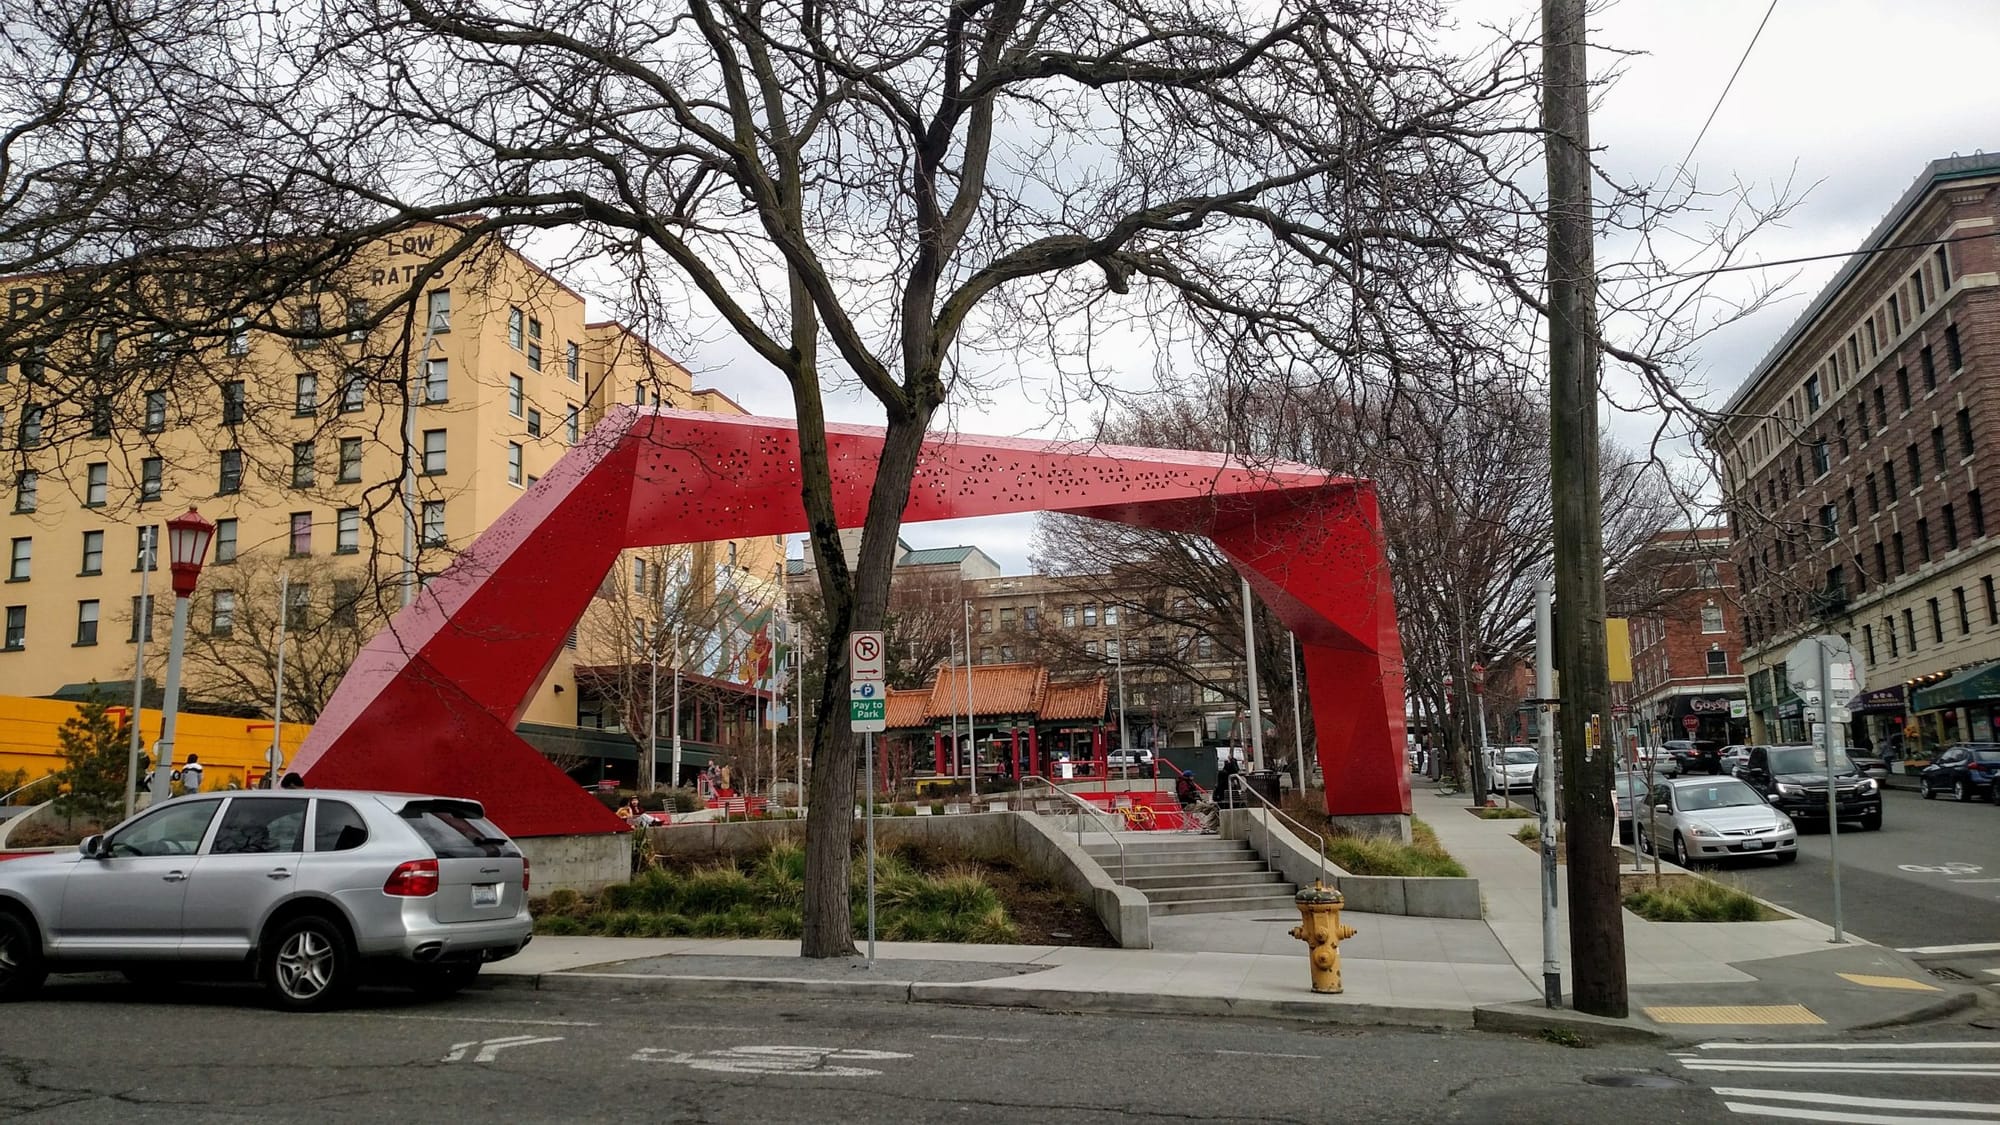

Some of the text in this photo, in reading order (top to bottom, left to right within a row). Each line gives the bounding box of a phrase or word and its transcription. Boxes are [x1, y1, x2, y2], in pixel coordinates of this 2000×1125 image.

[388, 234, 434, 256] LOW
[864, 686, 872, 696] P
[853, 701, 883, 711] Pay to
[857, 710, 879, 718] Park
